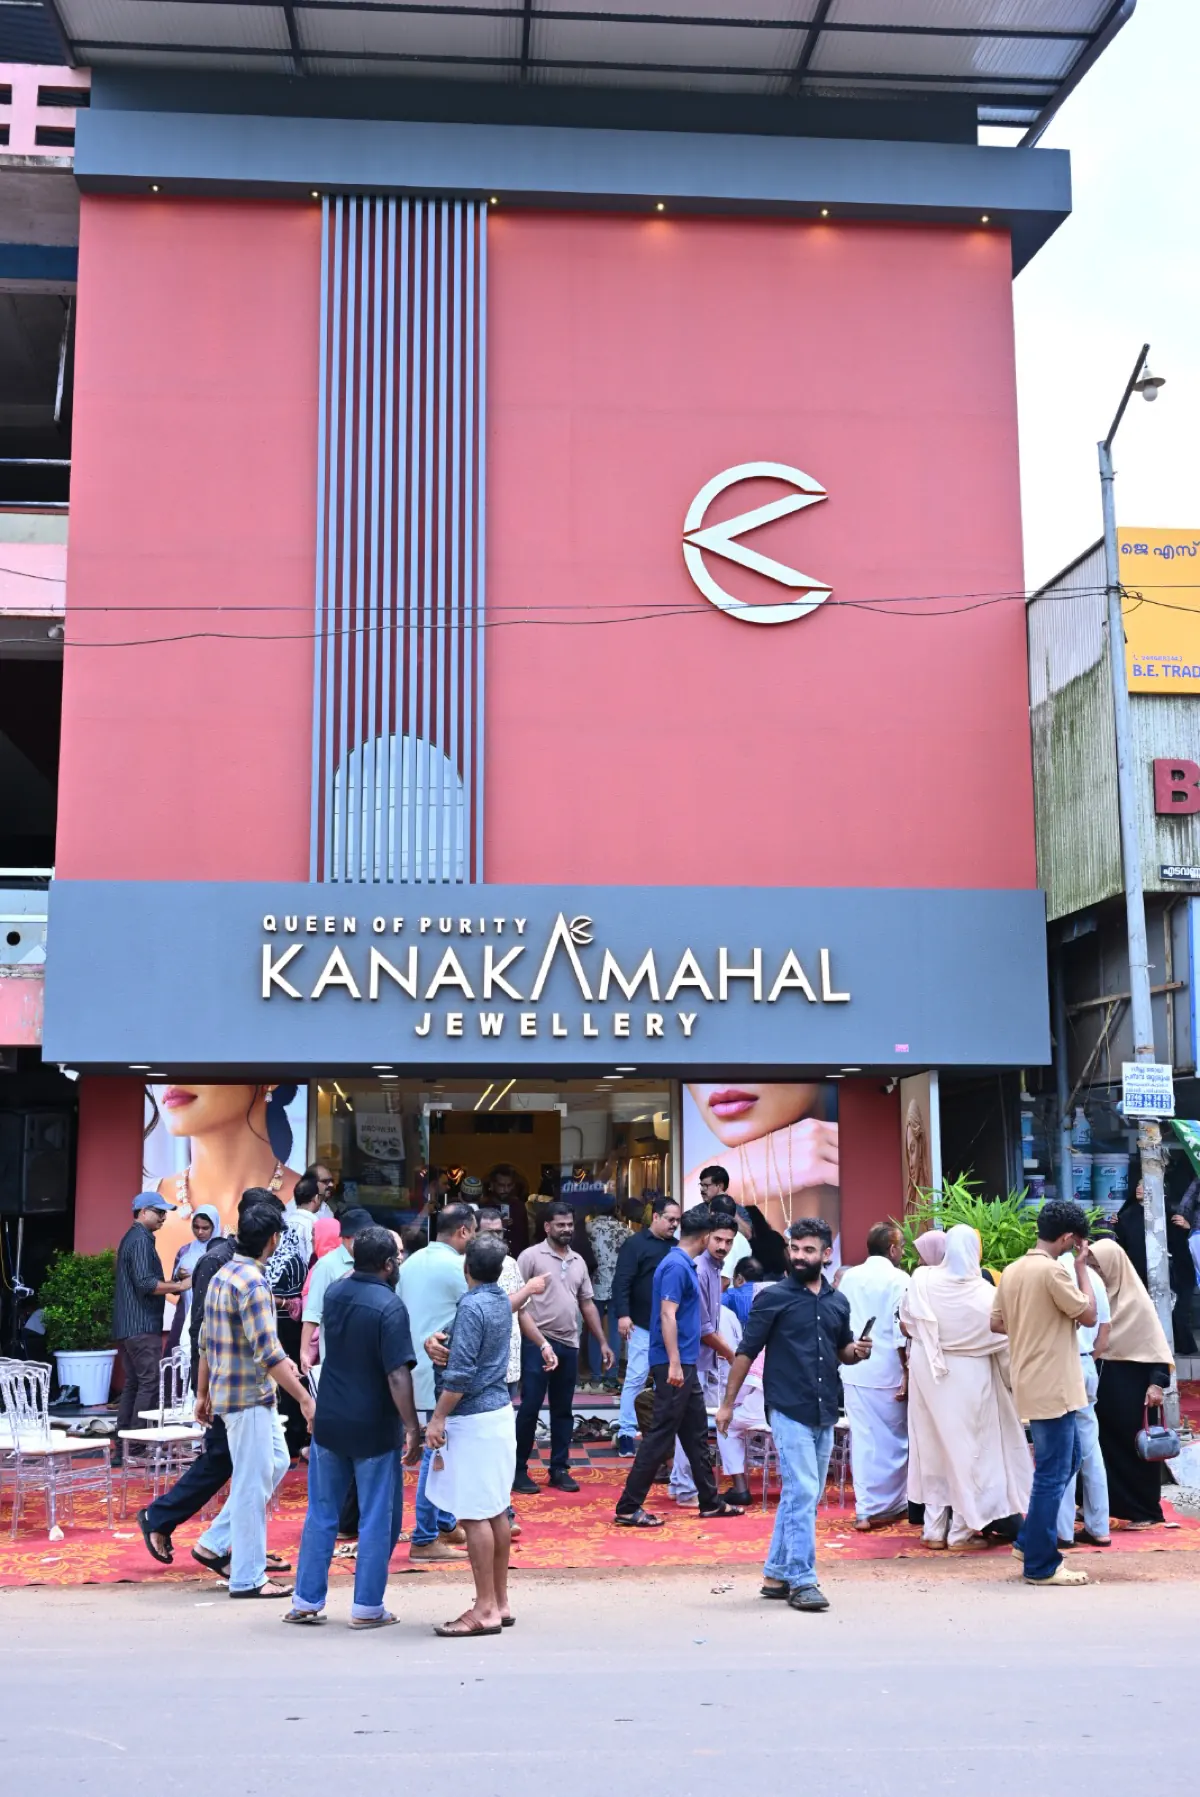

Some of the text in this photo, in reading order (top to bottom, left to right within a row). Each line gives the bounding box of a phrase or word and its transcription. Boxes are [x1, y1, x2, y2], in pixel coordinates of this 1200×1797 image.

[1121, 543, 1149, 556] ജെ
[1133, 664, 1200, 678] B.E. TRAD
[1153, 758, 1200, 815] B
[262, 914, 527, 934] QUEEN OF PURITY
[262, 912, 852, 1003] KANAKAMAHAL
[414, 1012, 698, 1037] JEWELLERY
